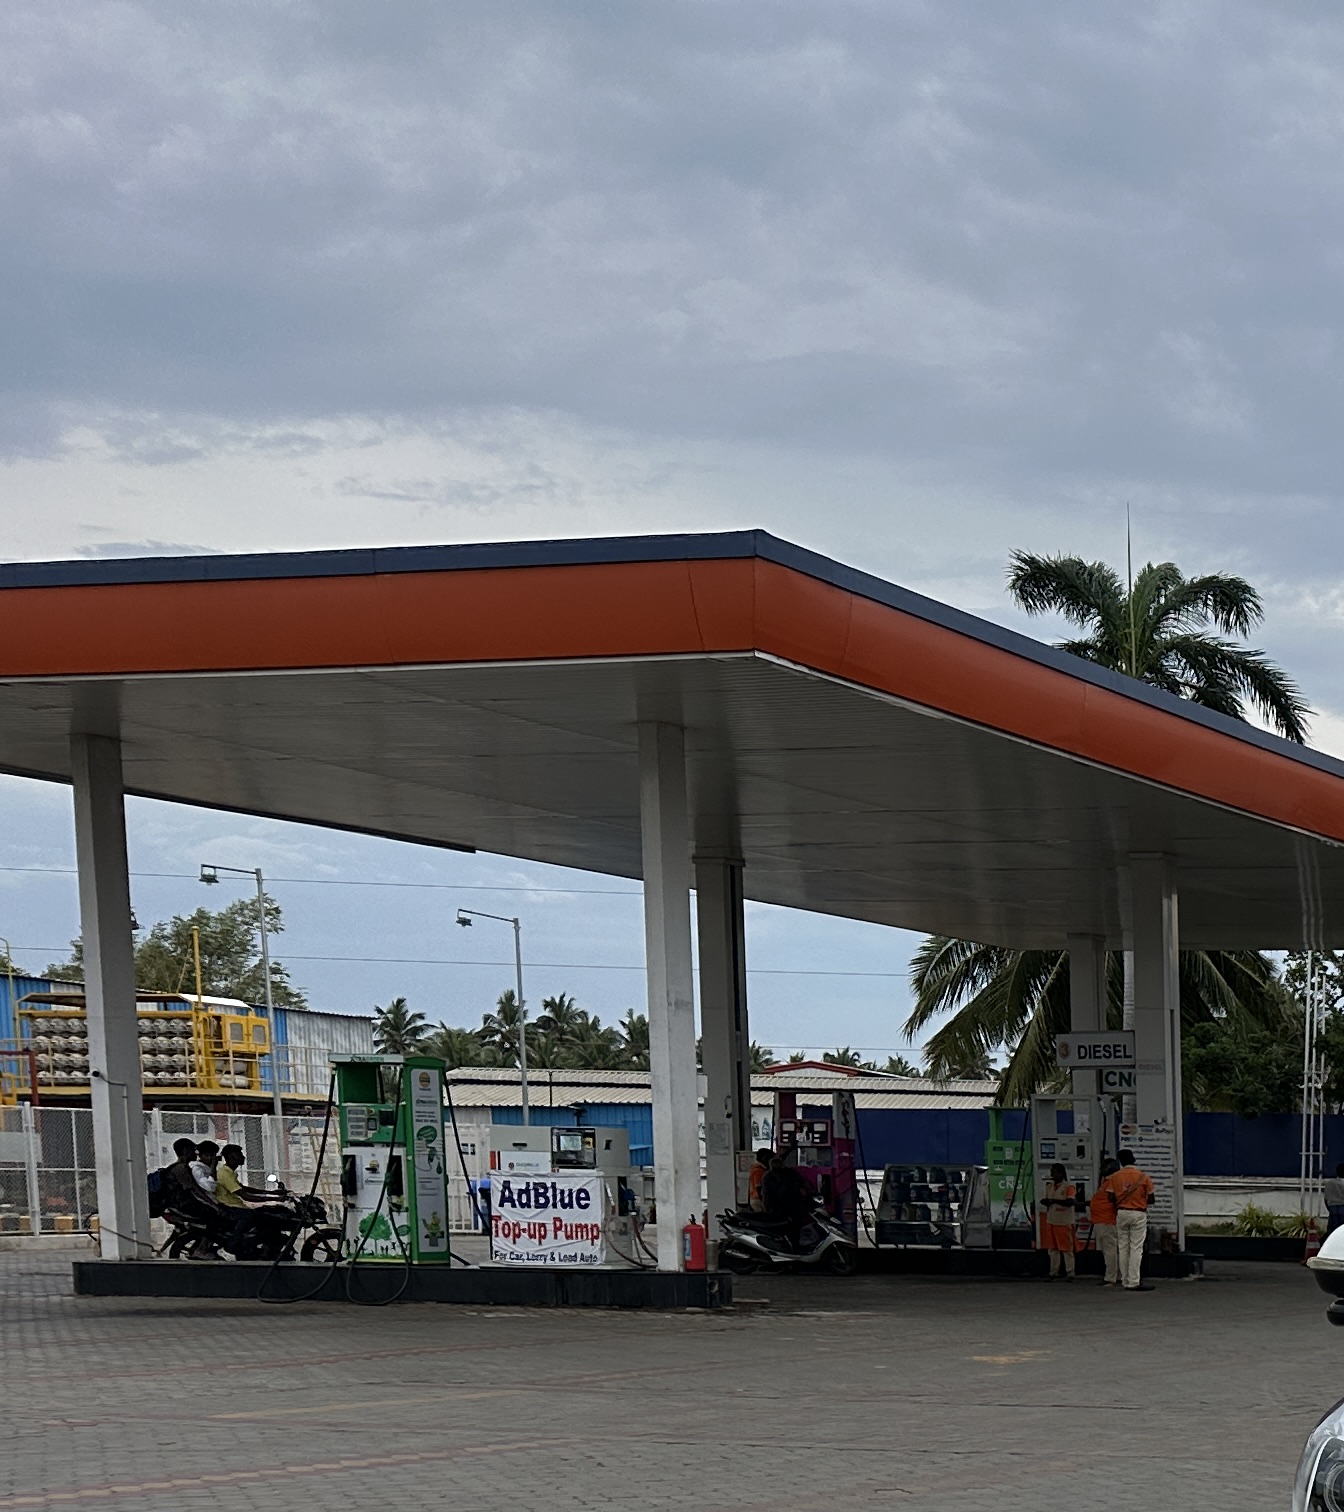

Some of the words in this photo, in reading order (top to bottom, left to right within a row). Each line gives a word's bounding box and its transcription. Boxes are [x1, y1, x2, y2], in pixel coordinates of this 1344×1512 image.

[1077, 1044, 1133, 1059] DIESEL
[1104, 1070, 1136, 1087] CN
[498, 1180, 591, 1210] AdBlue
[492, 1215, 548, 1246] Top-up
[553, 1217, 600, 1246] Pump
[494, 1250, 508, 1260] For
